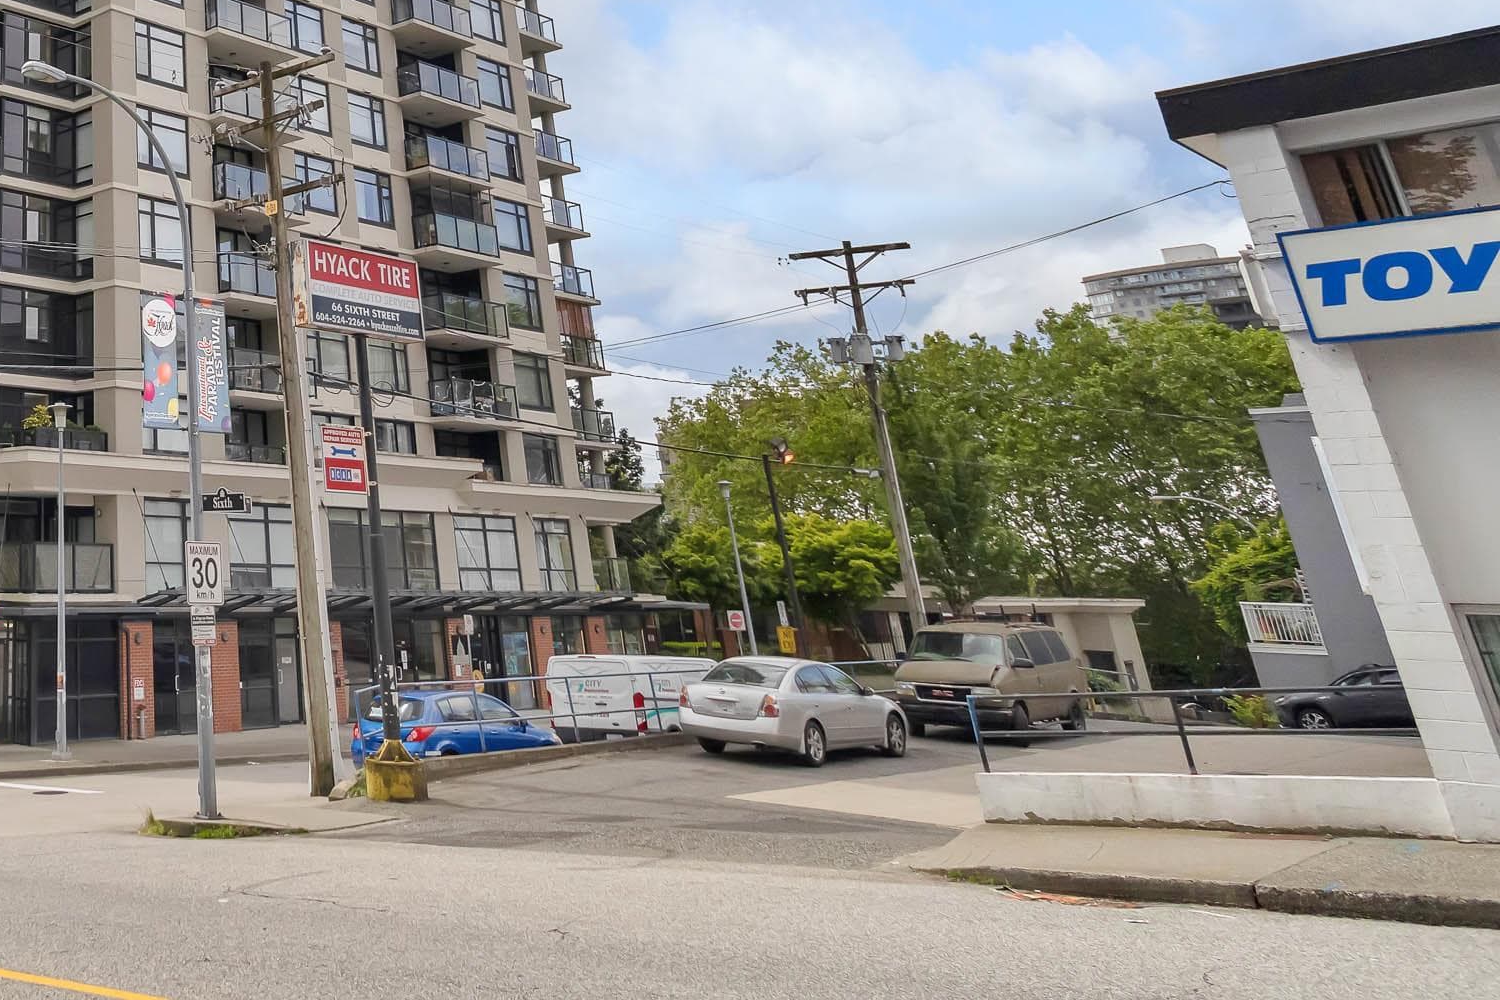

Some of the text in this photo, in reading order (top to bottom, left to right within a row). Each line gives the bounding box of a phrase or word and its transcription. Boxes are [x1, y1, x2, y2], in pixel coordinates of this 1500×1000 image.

[314, 250, 411, 289] HYACK TIRE
[360, 291, 380, 304] AUTO
[316, 312, 366, 328] 604-524-2264
[331, 302, 400, 322] 66 SIXTH STREET
[211, 317, 225, 385] FESTIVAL
[197, 337, 218, 416] PARADE &
[197, 356, 213, 422] International
[323, 429, 347, 437] APPROVED
[212, 498, 233, 509] Sixth
[189, 546, 218, 555] MAXIMUM
[192, 557, 218, 589] 30
[196, 590, 215, 599] km/h
